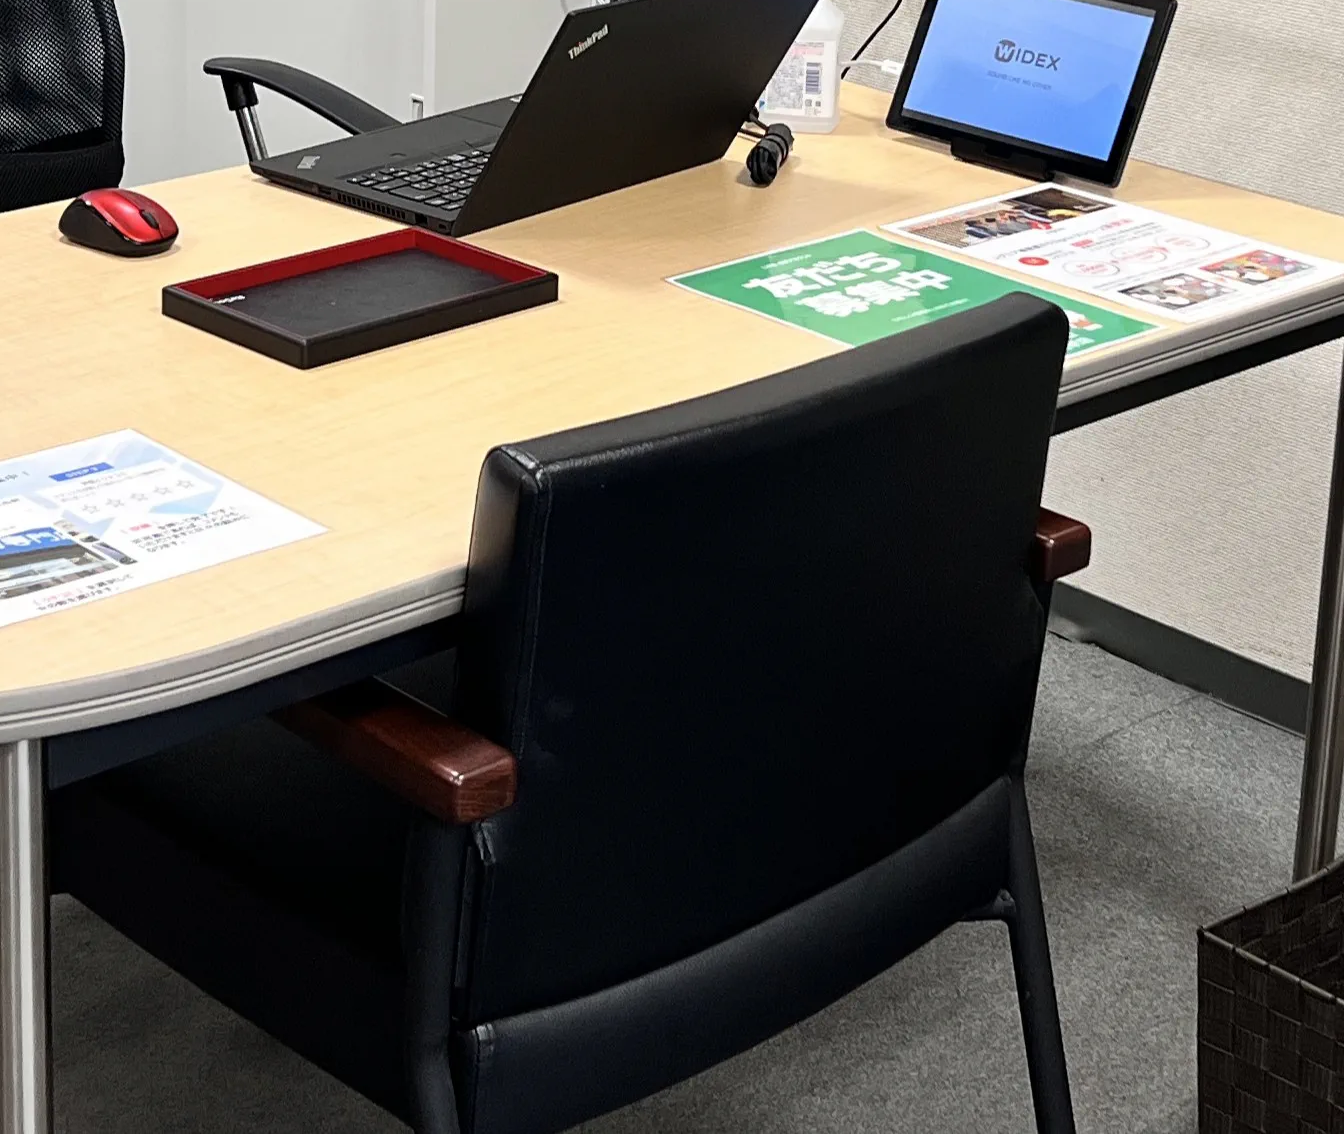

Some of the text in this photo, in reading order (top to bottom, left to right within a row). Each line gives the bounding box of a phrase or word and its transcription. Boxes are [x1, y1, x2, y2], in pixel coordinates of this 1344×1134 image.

[568, 23, 609, 60] ThinkPad
[994, 38, 1061, 71] WIDEX
[741, 251, 902, 299] 友だち
[794, 269, 953, 317] 募集中
